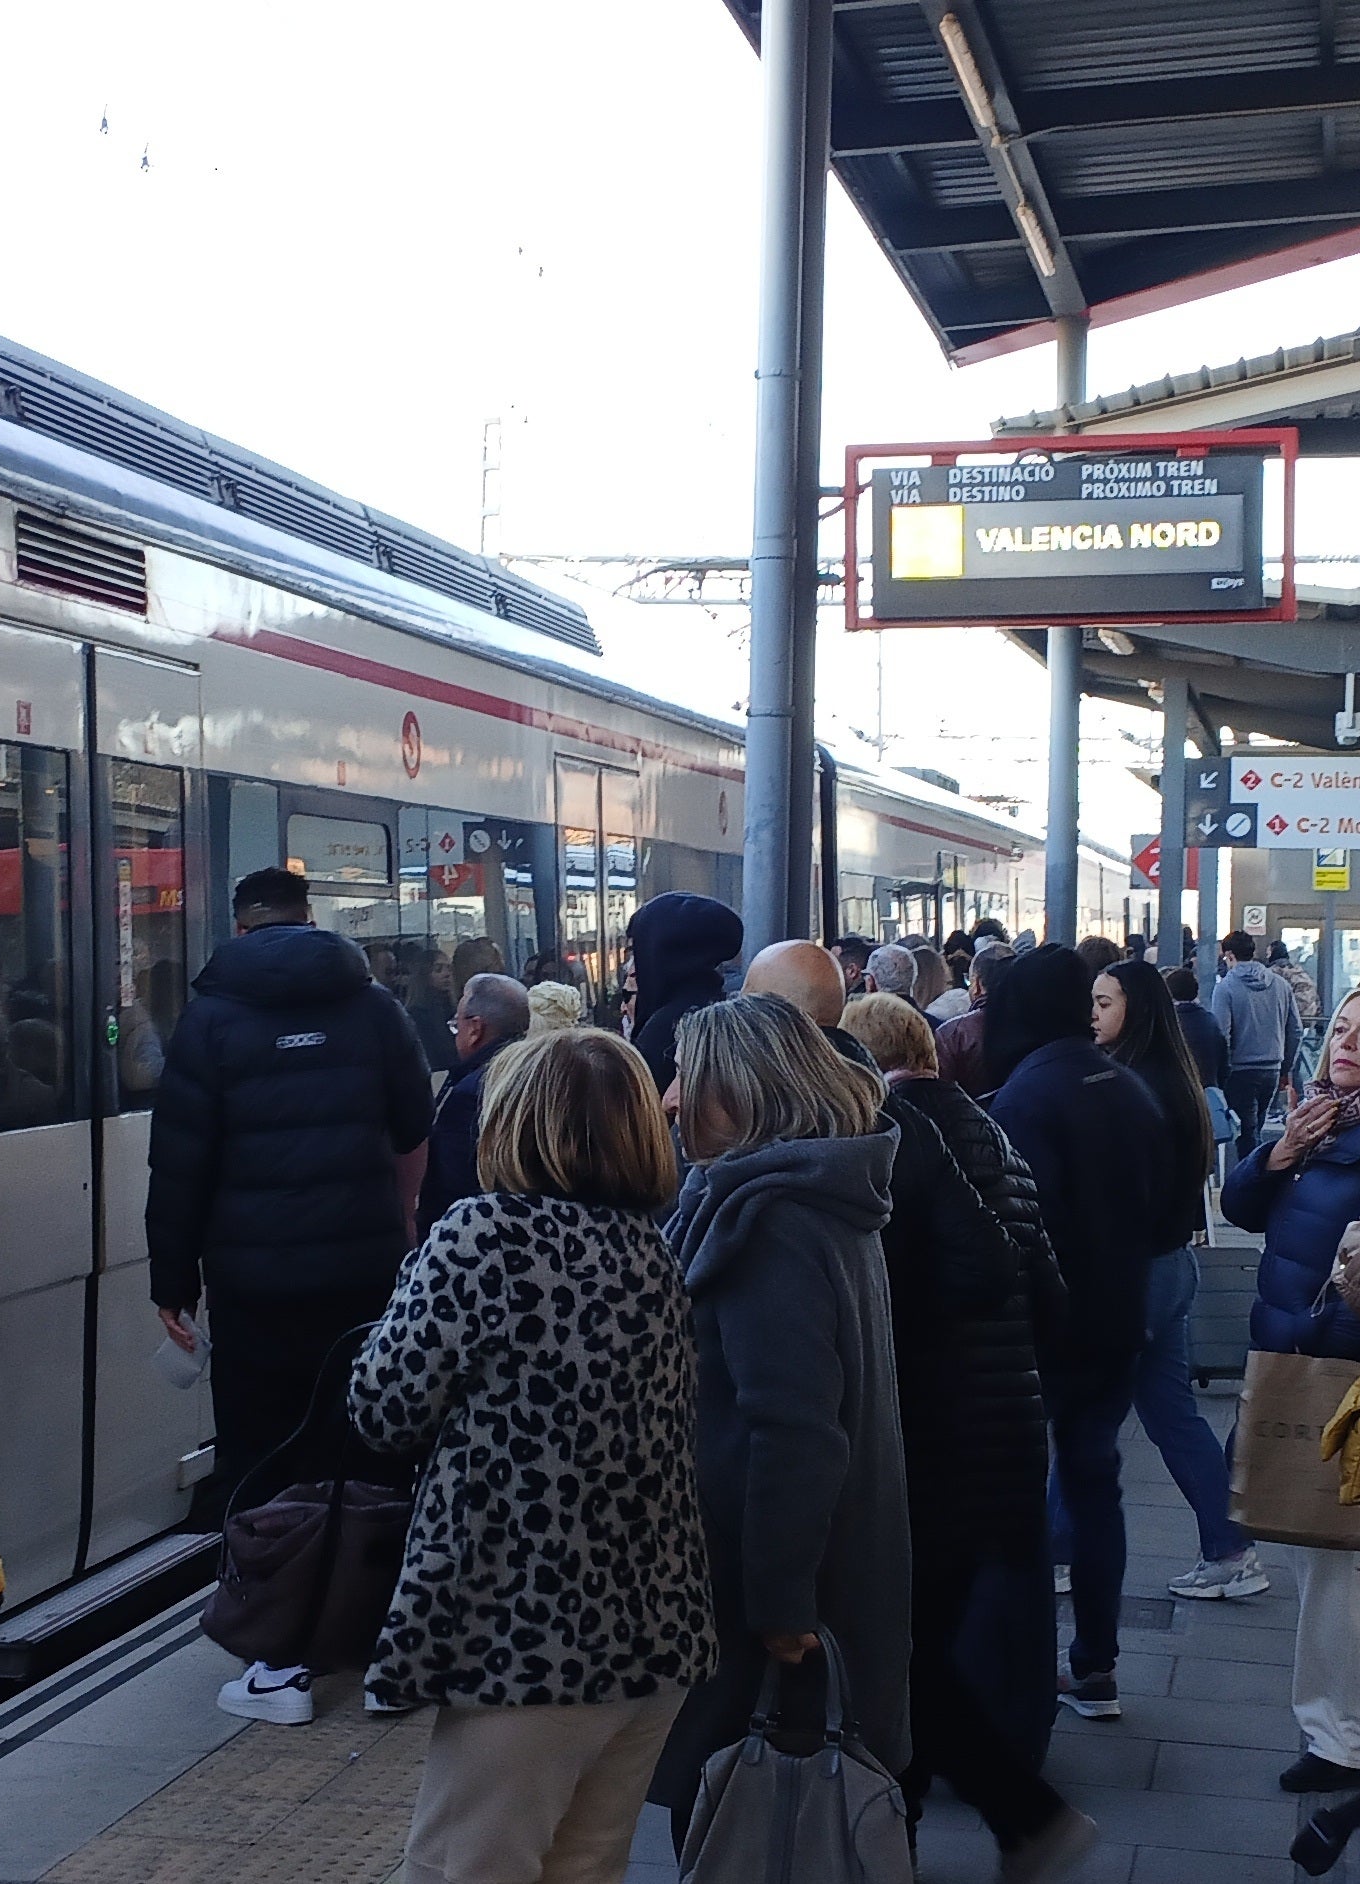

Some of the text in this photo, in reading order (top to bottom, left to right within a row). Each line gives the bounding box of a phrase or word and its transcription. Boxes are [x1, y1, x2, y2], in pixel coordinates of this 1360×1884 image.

[890, 459, 1204, 486] VIA DESTINACIÓ PRÓXIM TREN
[890, 478, 1218, 504] VÍA DESTINO PRÓXIMO TREN
[975, 520, 1221, 553] VALENCIA NORD
[1245, 772, 1257, 788] 2
[1270, 772, 1304, 789] C-2
[1273, 819, 1283, 832] 1
[1296, 817, 1330, 834] C-2
